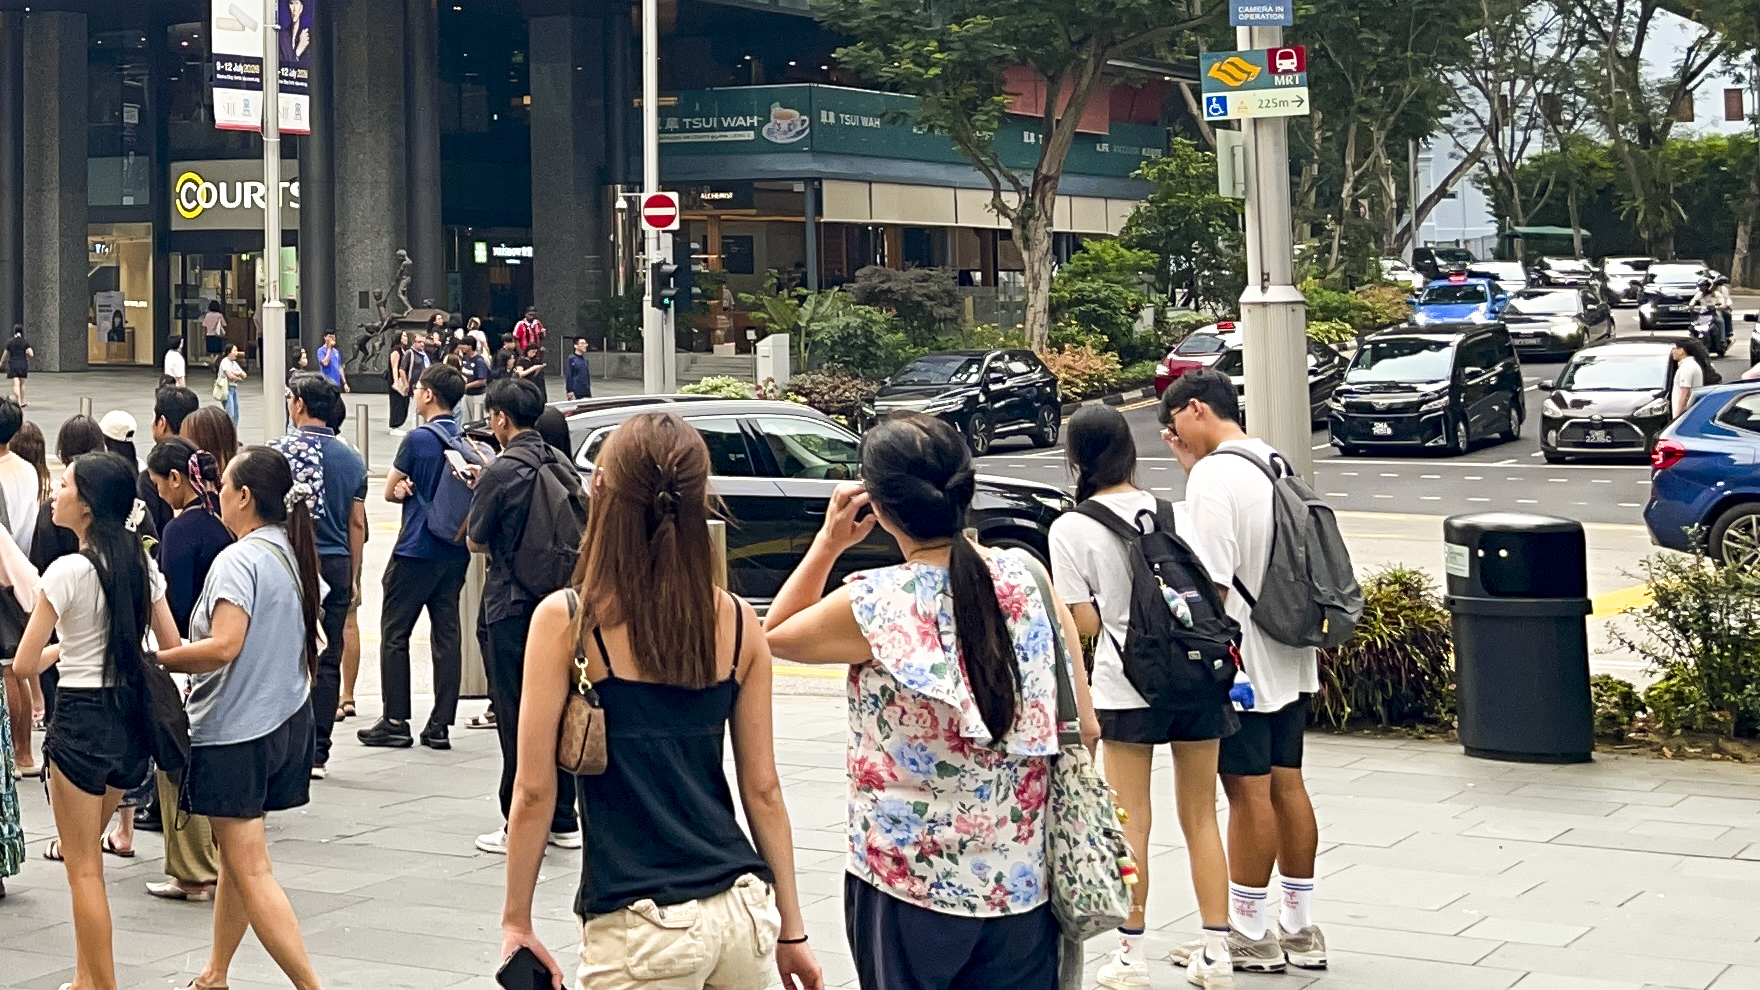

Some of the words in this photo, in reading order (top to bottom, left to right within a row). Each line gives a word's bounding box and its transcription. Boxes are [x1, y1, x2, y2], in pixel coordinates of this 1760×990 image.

[1238, 5, 1274, 13] CAMERA
[1275, 5, 1284, 13] IN
[1238, 13, 1285, 21] OPERATION
[1274, 74, 1301, 86] MRT
[1258, 98, 1289, 109] 225m
[682, 117, 717, 129] TSUI
[721, 115, 758, 127] WAH
[839, 113, 859, 126] TSUI
[861, 116, 881, 128] WAH
